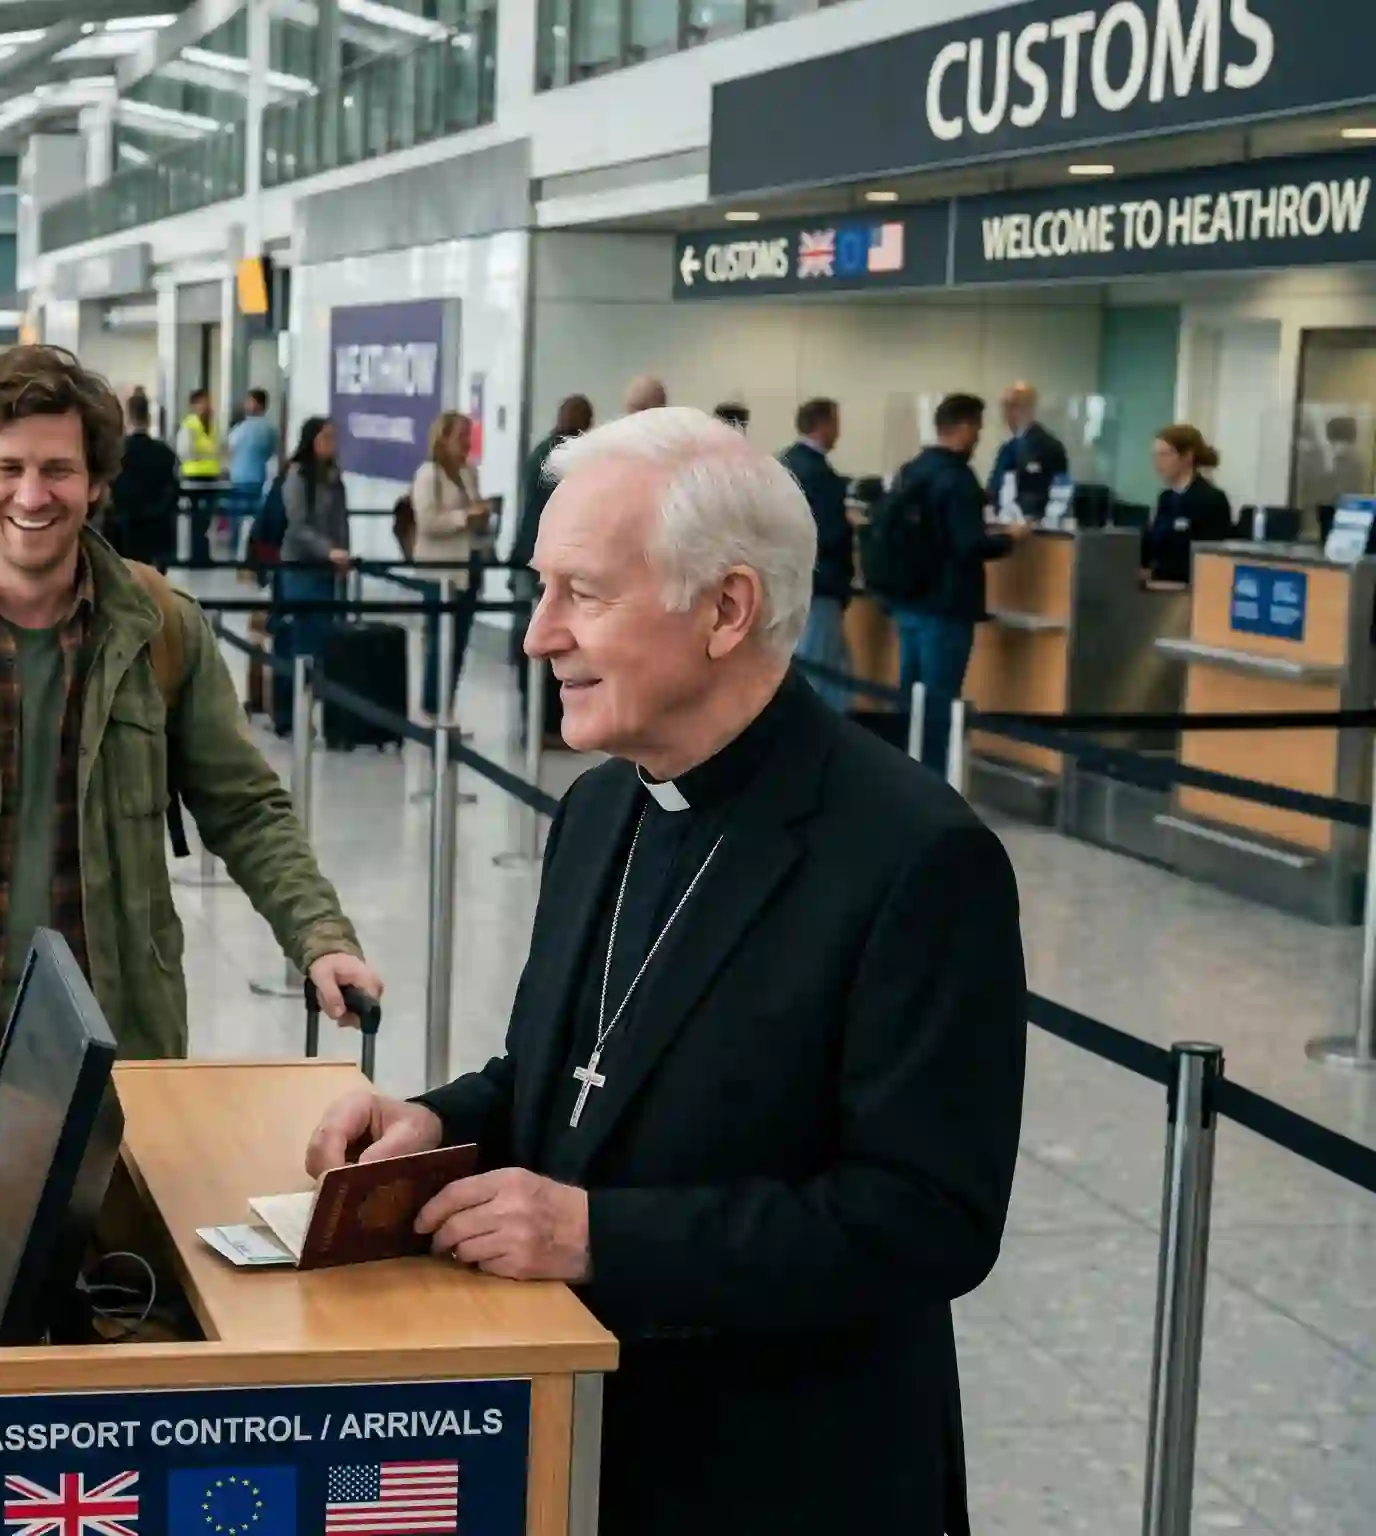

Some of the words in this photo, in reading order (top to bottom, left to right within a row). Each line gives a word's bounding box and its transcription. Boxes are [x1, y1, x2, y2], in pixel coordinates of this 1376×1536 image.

[925, 0, 1275, 141] CUSTOMS
[982, 205, 1116, 260] WELCOME
[1120, 202, 1162, 250] TO
[1167, 176, 1371, 247] HEATHROW
[705, 237, 789, 282] CUSTOMS
[150, 1415, 313, 1447] CONTROL
[320, 1413, 332, 1441] /
[339, 1408, 503, 1439] ARRIVALS
